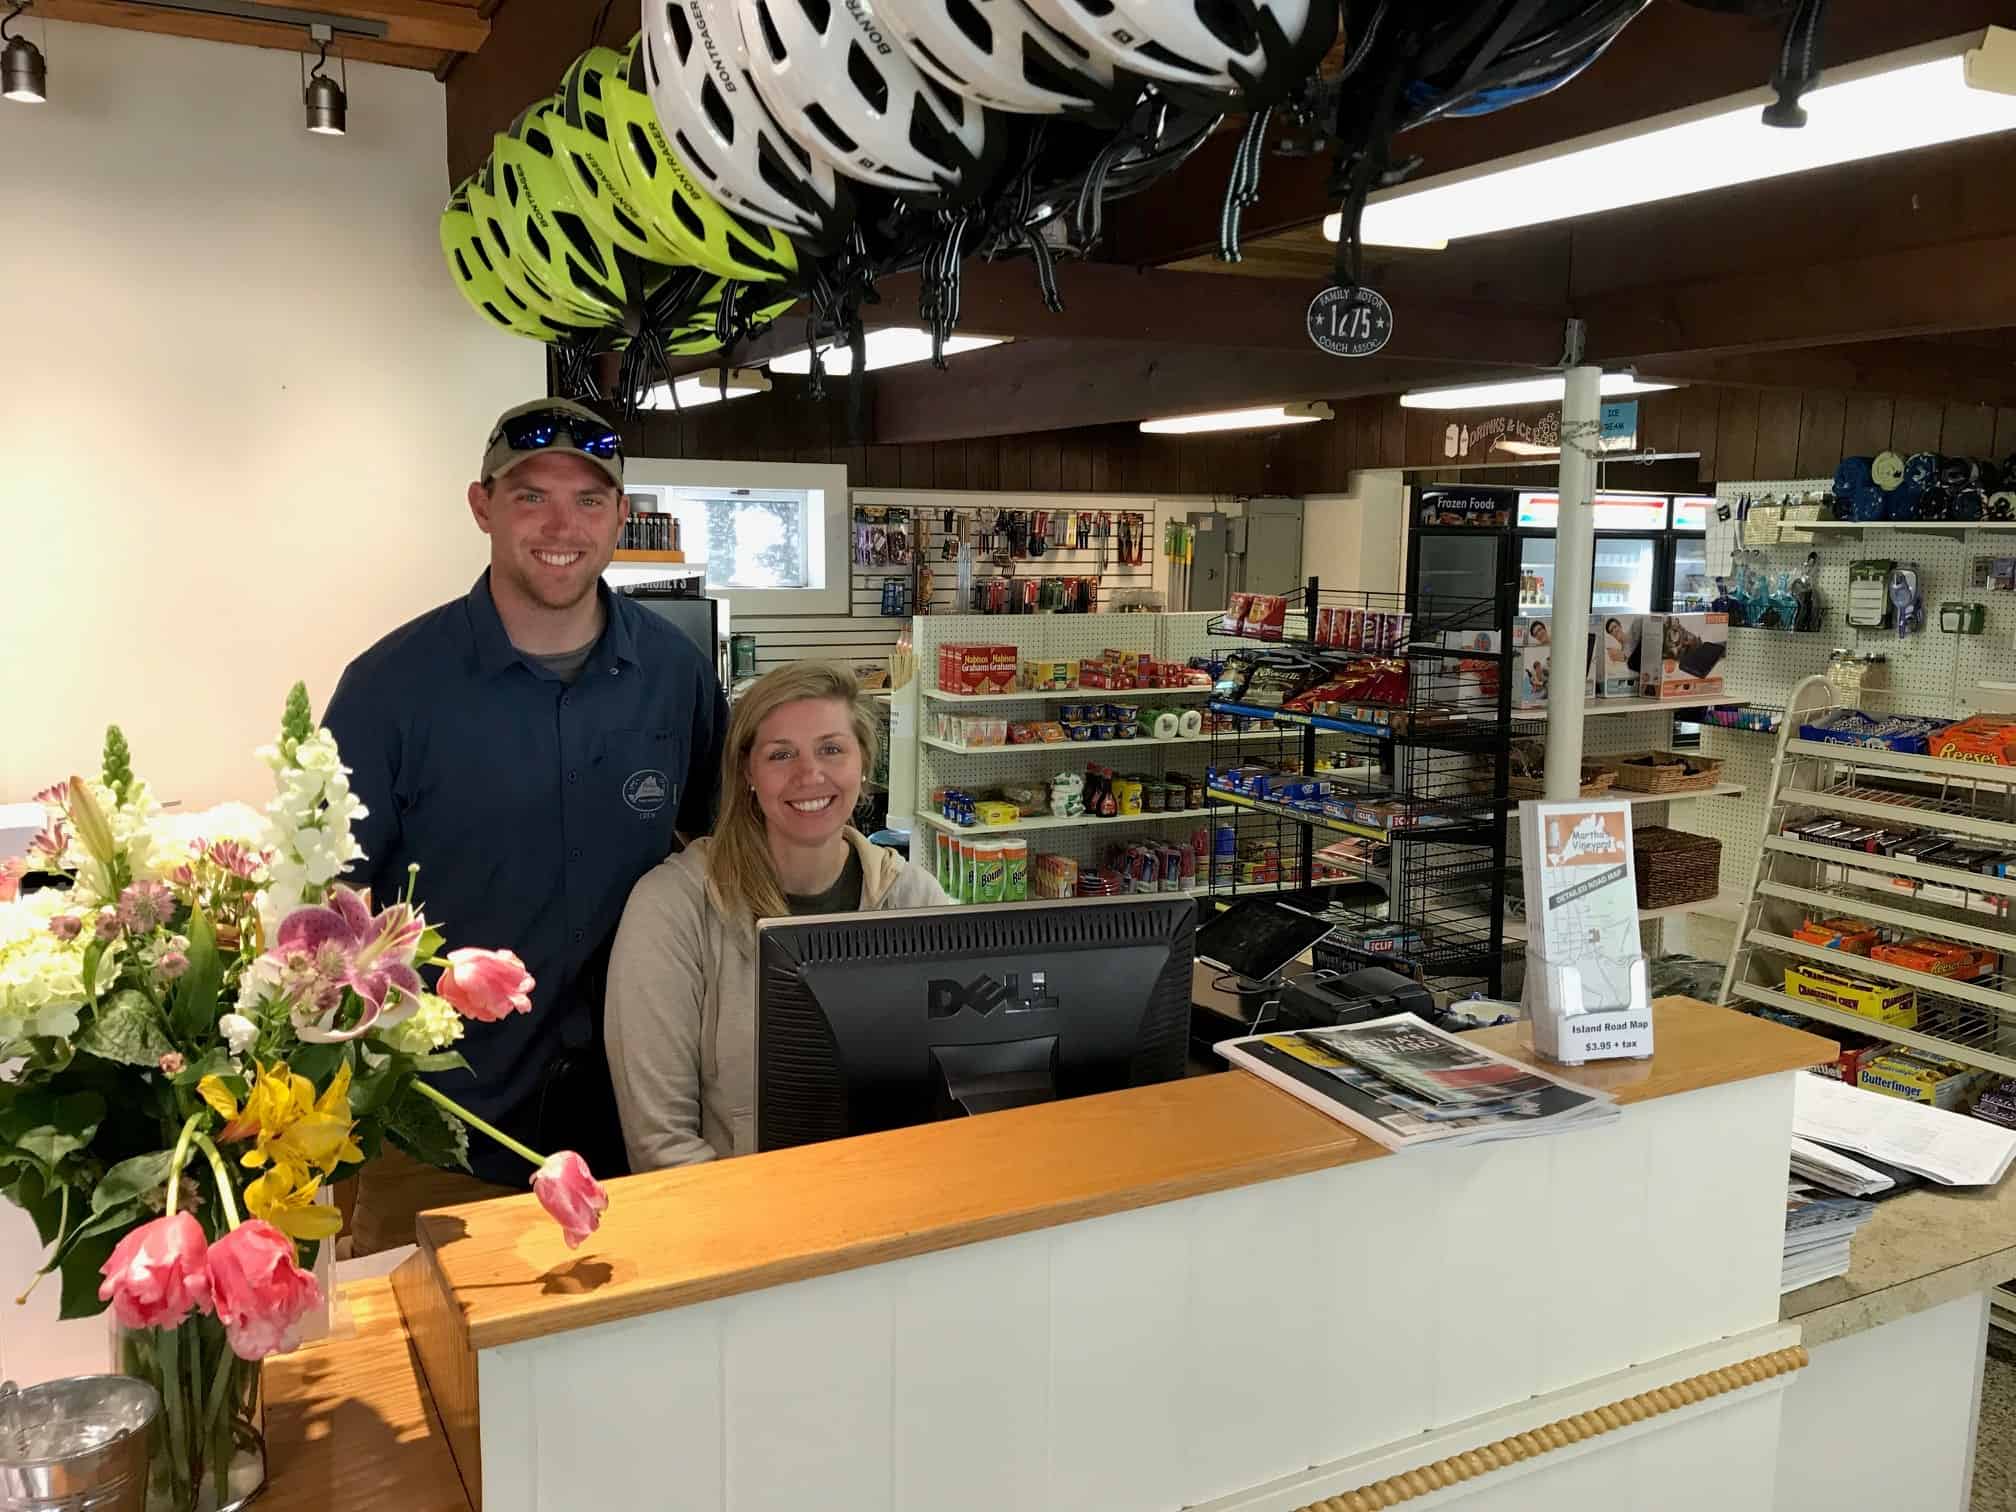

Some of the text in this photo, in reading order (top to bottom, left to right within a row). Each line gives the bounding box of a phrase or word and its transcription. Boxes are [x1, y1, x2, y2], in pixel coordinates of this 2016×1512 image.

[845, 0, 893, 55] BONTR
[689, 0, 737, 93] BONTRAGER
[648, 121, 702, 201] BONTRAGER
[585, 151, 640, 219] BONTRAGER
[1320, 288, 1350, 306] FAMILY
[1319, 335, 1348, 353] COACH
[1607, 408, 1621, 417] ICE
[1470, 417, 1505, 447] DRINKS
[1507, 419, 1515, 432] &
[1603, 422, 1625, 431] REAM
[1437, 496, 1495, 510] Frozen Foods
[1938, 743, 1999, 765] Reese's
[1374, 940, 1393, 951] CLIF
[927, 972, 1060, 1019] DELL
[1838, 997, 1860, 1012] CHEW
[1572, 1020, 1649, 1034] Island Road Map
[1585, 1041, 1612, 1052] $3.95
[1622, 1040, 1637, 1049] tax
[1862, 1071, 1923, 1096] Butterfinger
